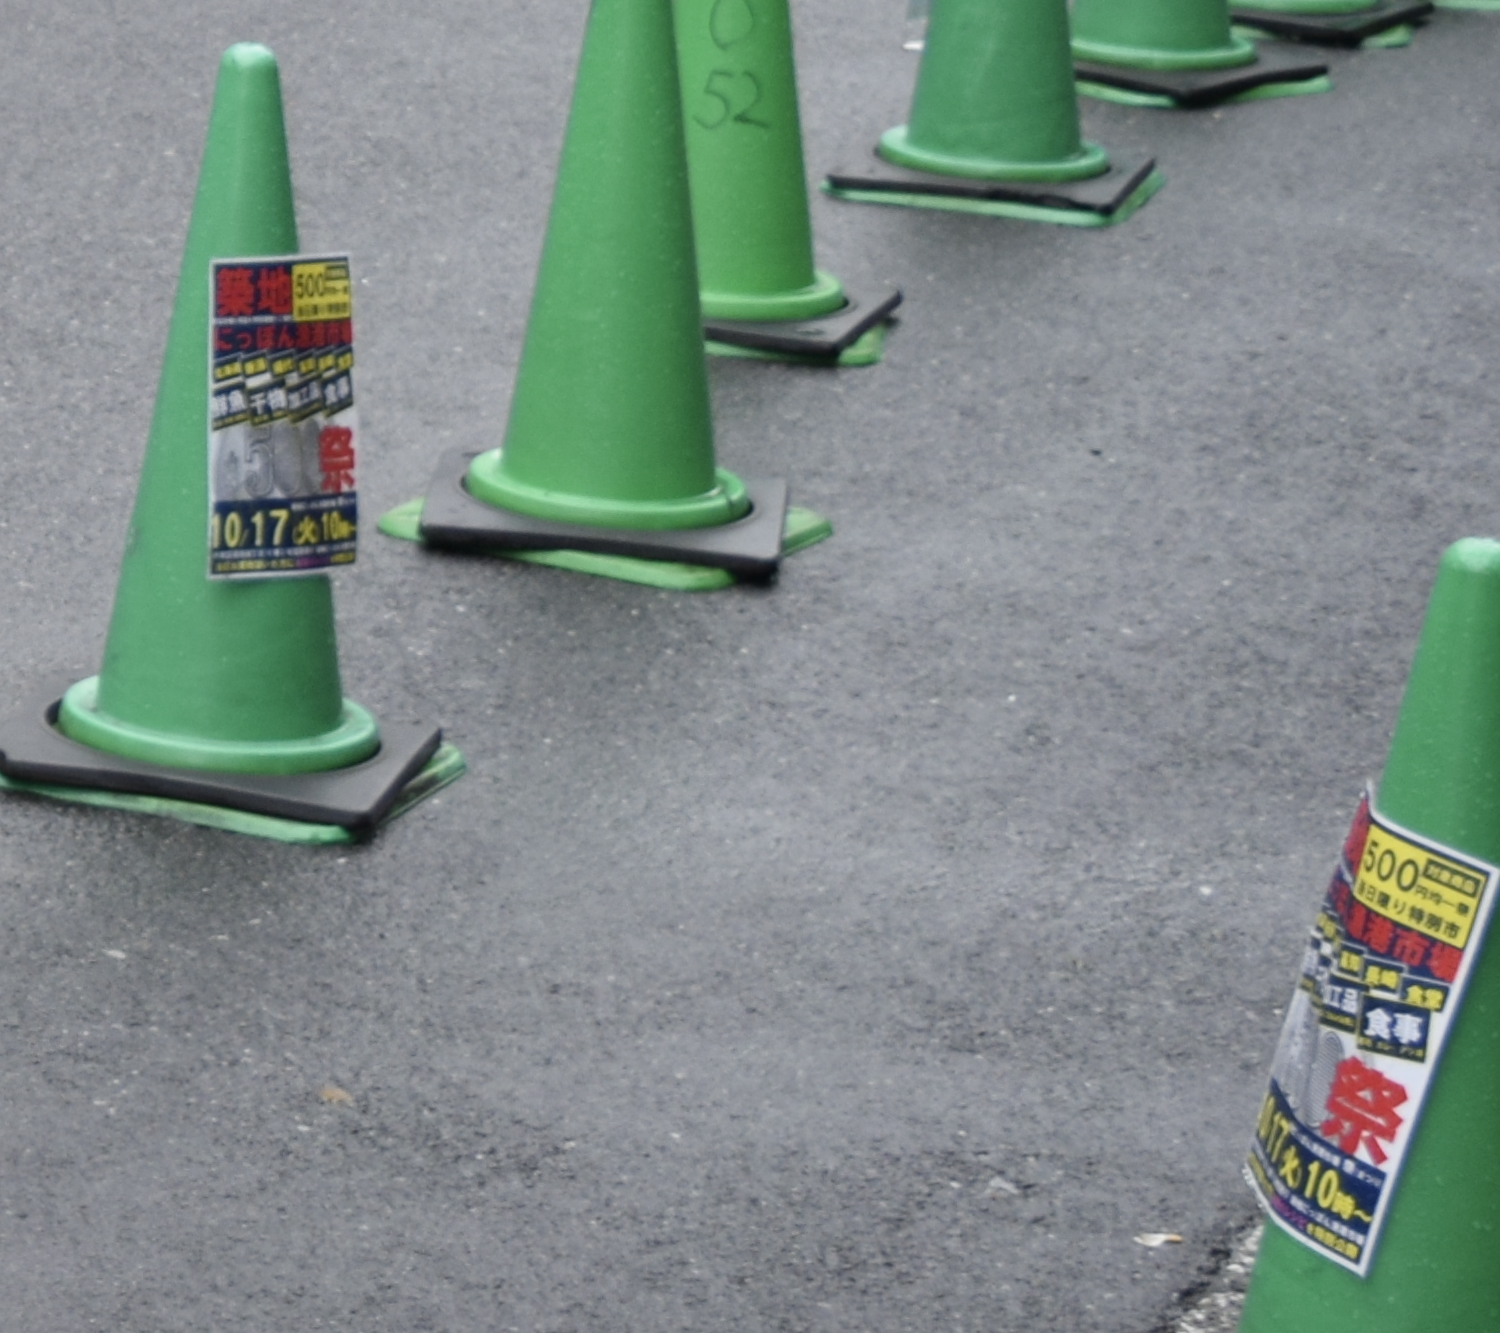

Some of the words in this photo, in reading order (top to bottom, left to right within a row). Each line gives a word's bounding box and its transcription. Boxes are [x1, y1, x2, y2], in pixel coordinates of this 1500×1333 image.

[693, 69, 772, 130] 52
[216, 266, 293, 316] 築地
[318, 426, 356, 493] 祭
[1361, 840, 1420, 893] 500
[1364, 1007, 1424, 1045] 食事
[1321, 1054, 1408, 1165] 祭
